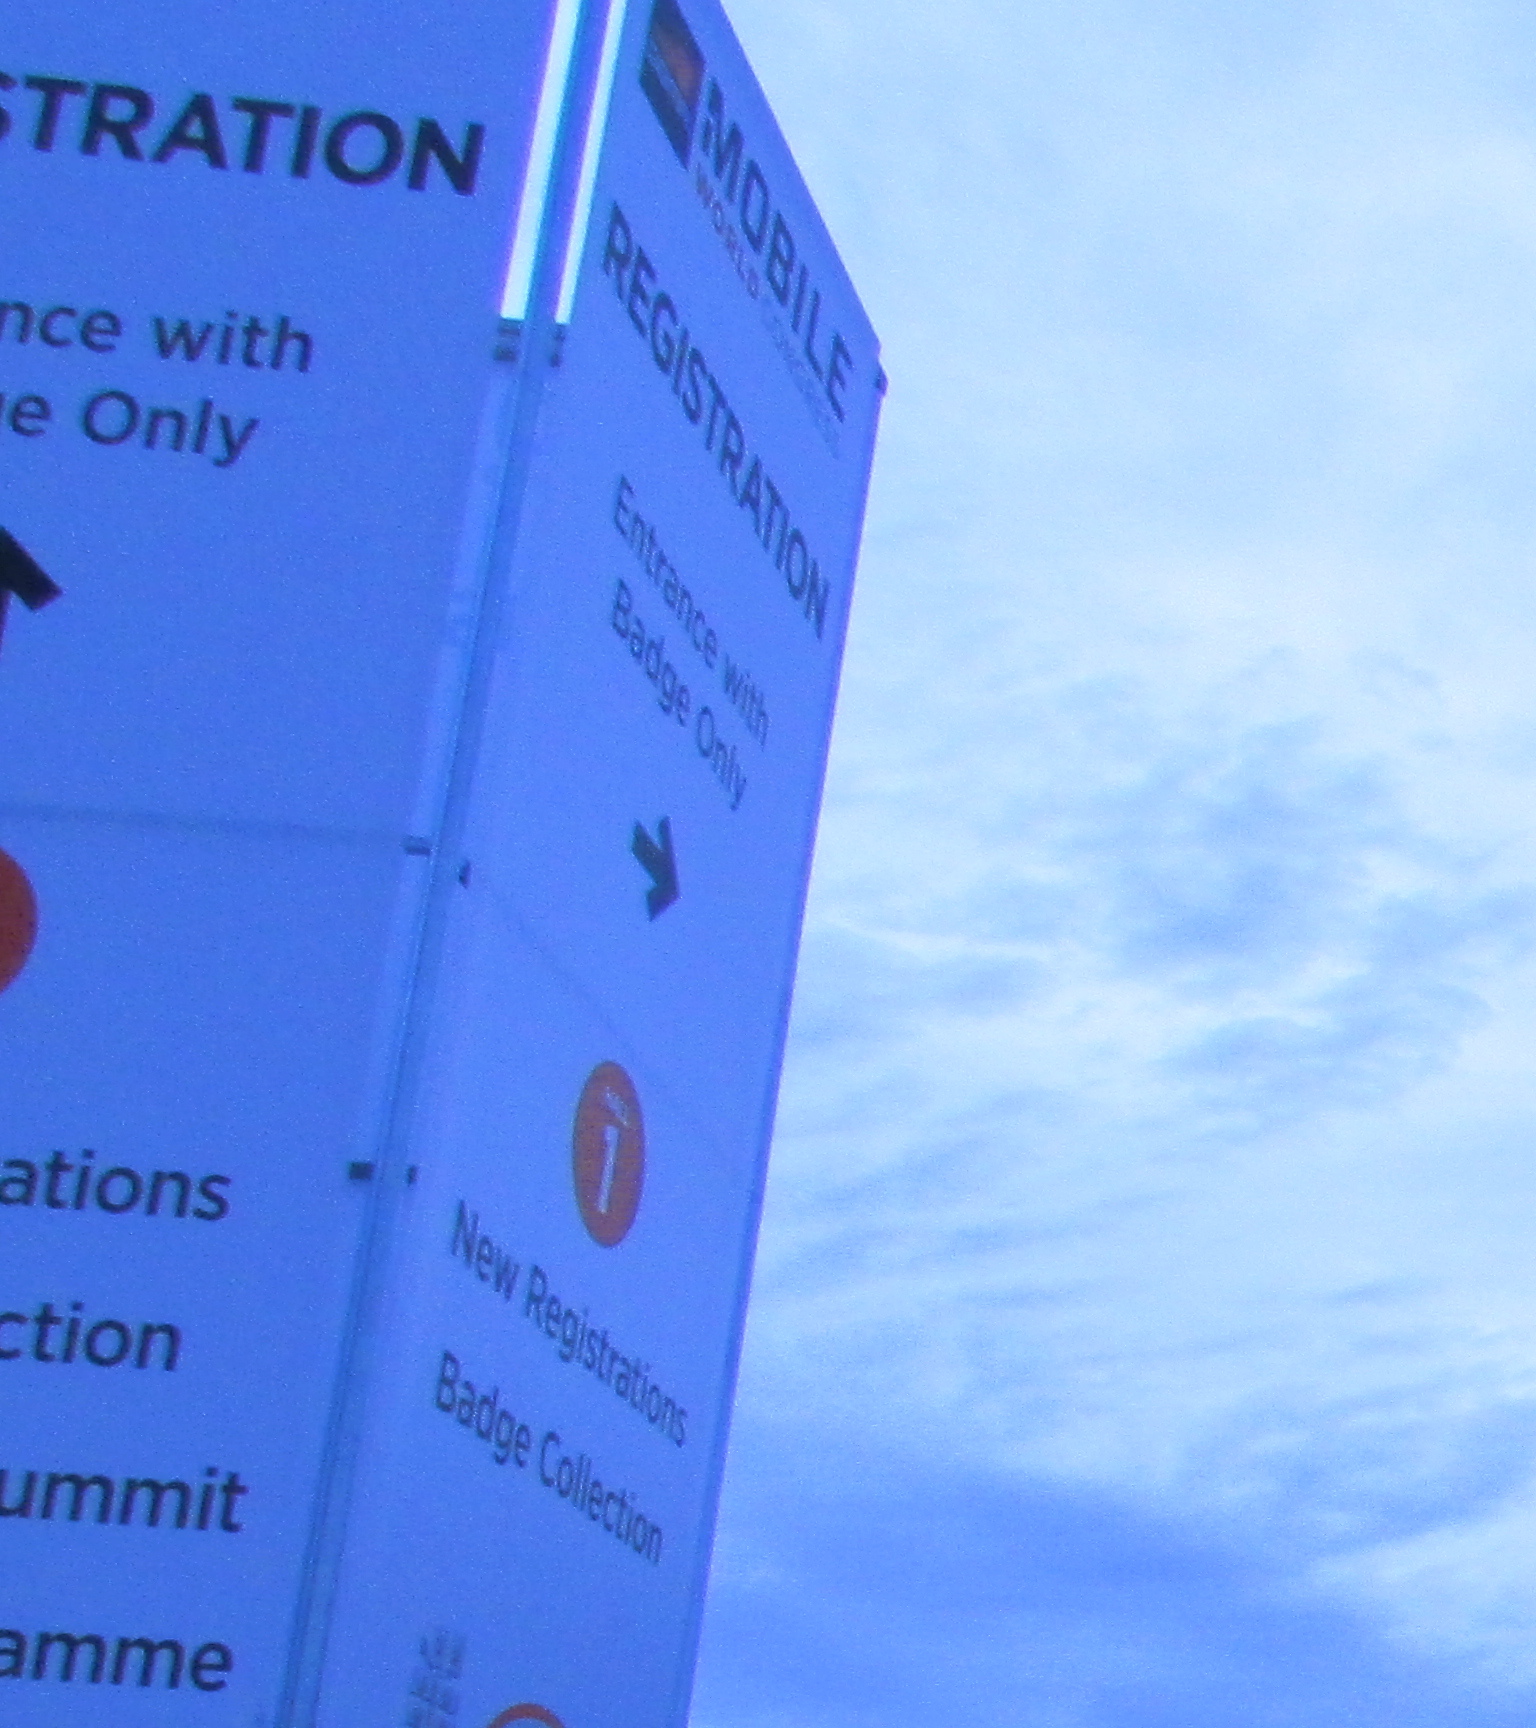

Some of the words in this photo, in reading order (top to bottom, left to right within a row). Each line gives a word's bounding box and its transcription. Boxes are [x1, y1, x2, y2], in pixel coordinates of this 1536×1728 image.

[153, 313, 313, 372] with
[702, 76, 853, 424] MOBILE
[82, 390, 260, 467] Only
[603, 200, 829, 641] REGISTRATION
[612, 577, 690, 727] Badge
[697, 706, 747, 811] Only
[614, 474, 718, 670] Entrance
[724, 653, 769, 751] with
[452, 1200, 519, 1300] New
[525, 1263, 687, 1448] Registrations
[435, 1350, 531, 1467] Badge
[540, 1431, 663, 1566] Collection
